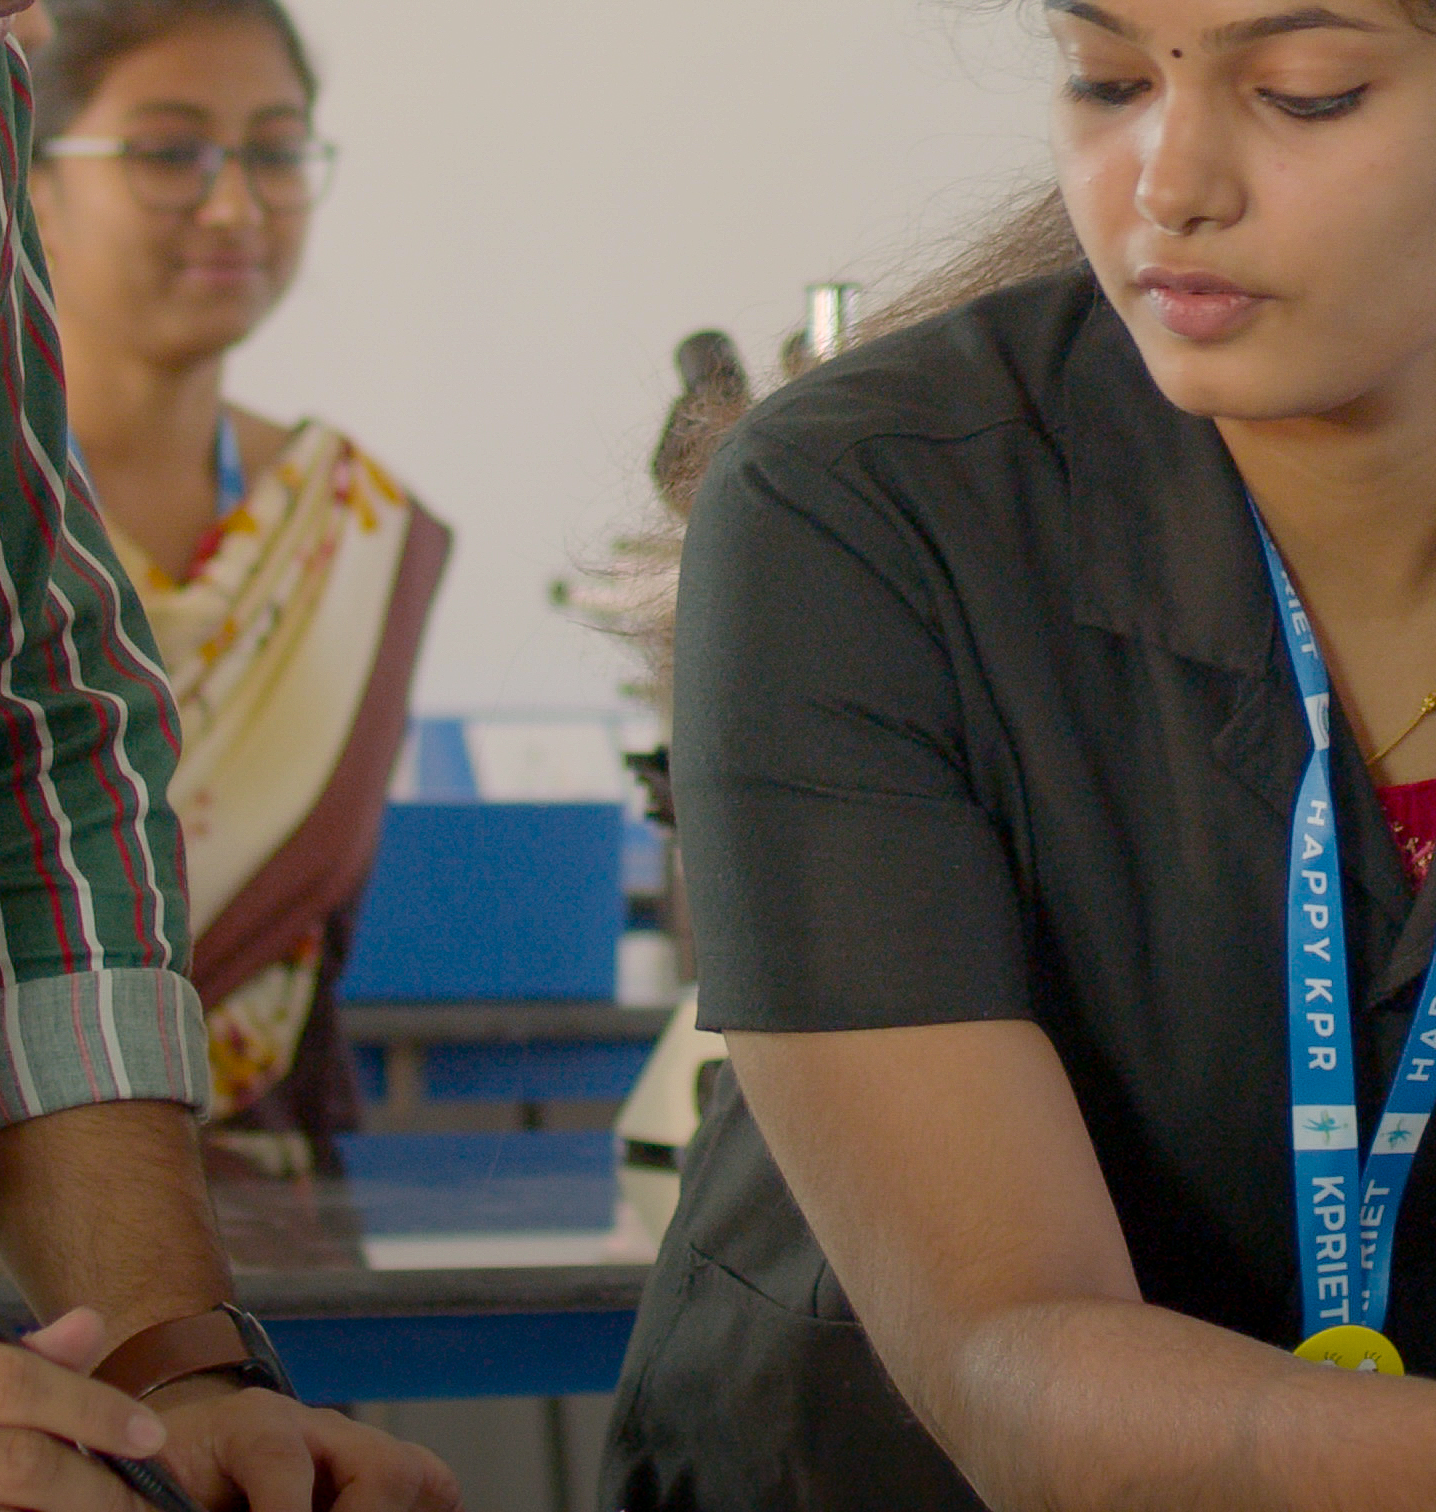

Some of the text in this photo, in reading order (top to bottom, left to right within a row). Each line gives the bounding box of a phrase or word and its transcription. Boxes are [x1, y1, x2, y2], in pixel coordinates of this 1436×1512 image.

[1301, 799, 1337, 1072] HAPPY KPR
[1312, 1176, 1350, 1324] KPRIET
